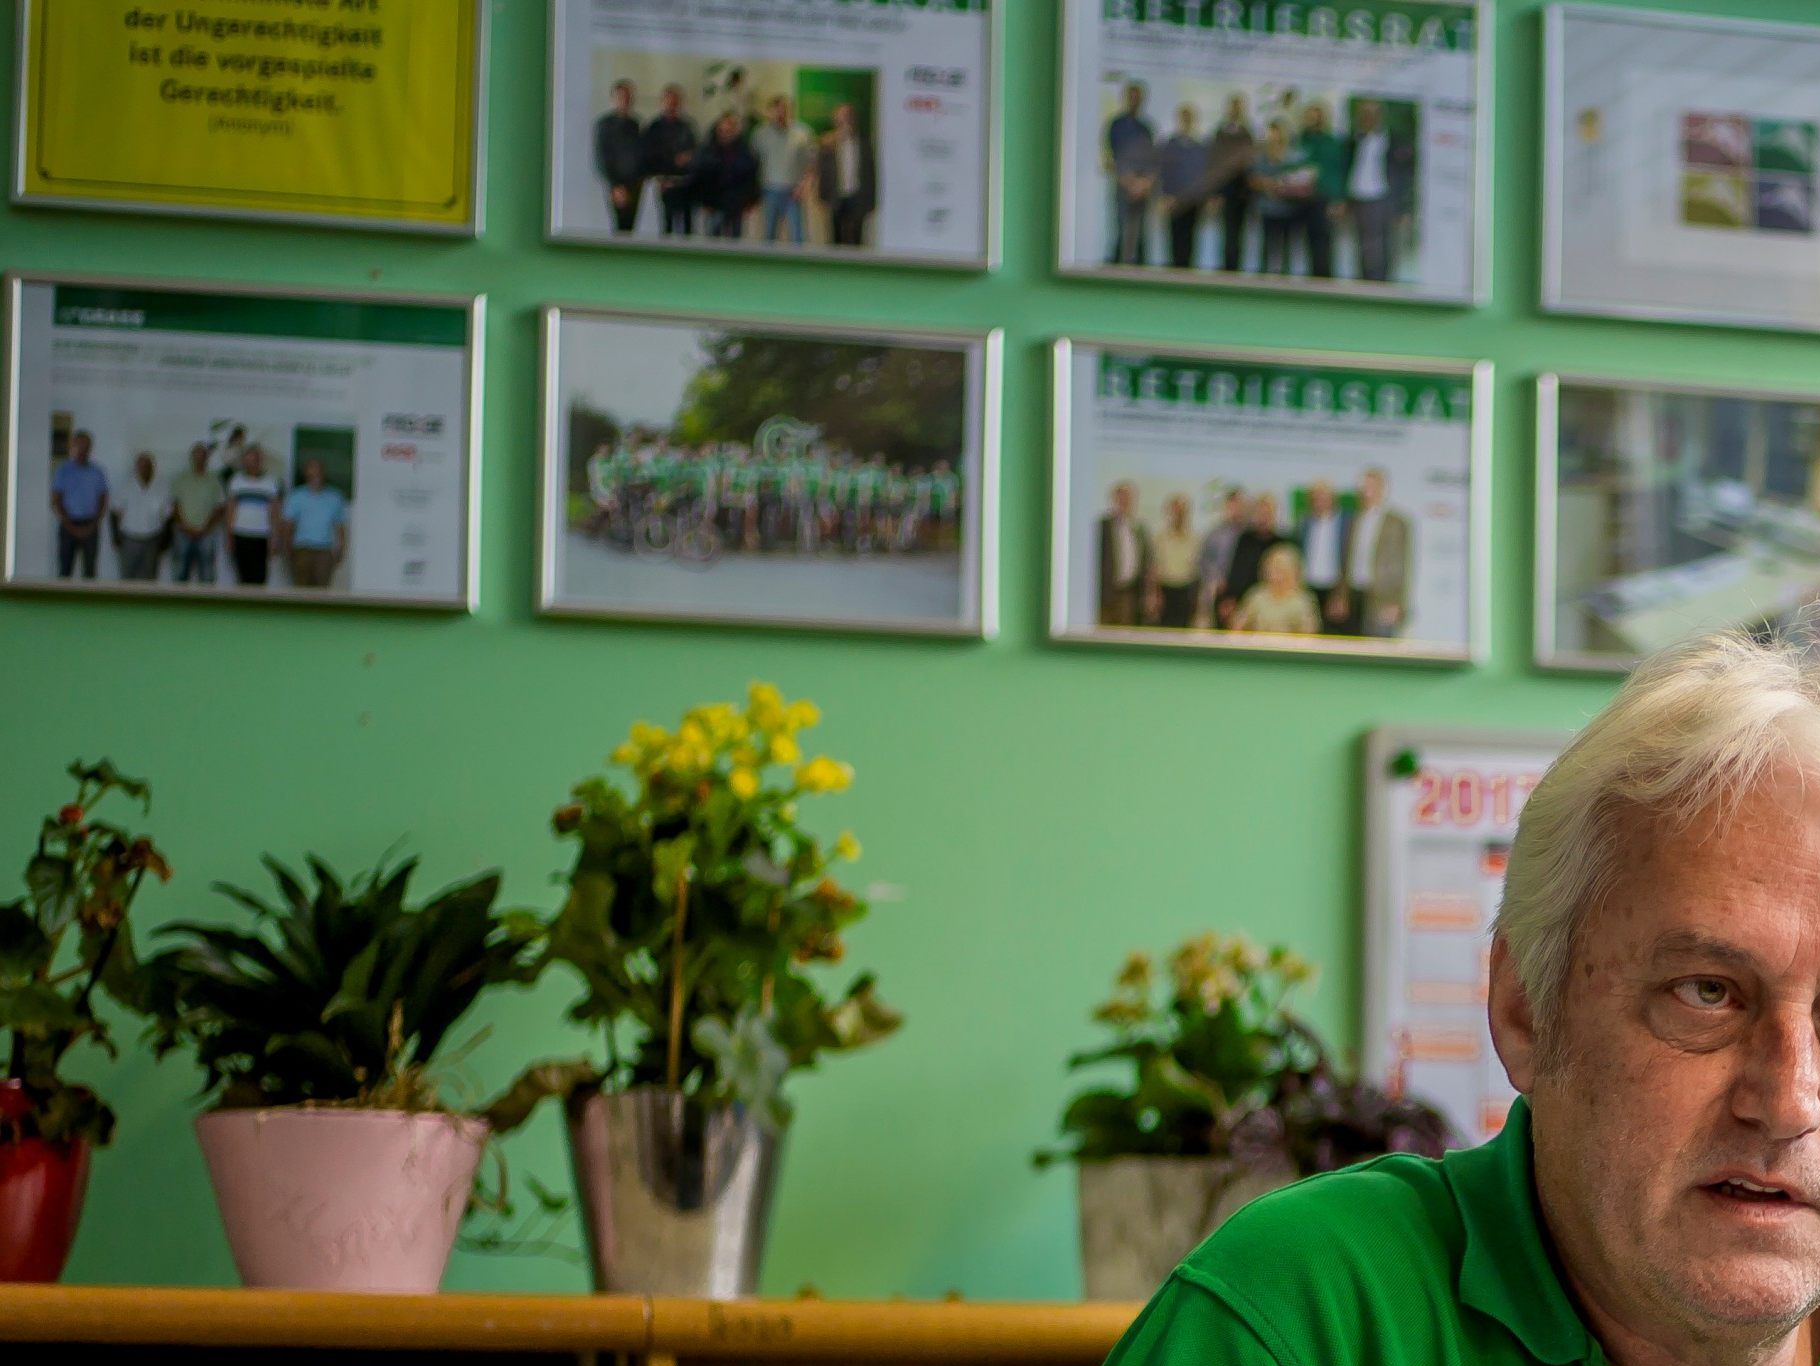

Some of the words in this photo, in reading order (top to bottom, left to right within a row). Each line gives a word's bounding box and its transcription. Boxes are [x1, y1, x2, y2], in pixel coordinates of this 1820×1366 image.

[125, 7, 167, 29] der
[175, 9, 381, 48] Ungerechtigkeit
[170, 44, 210, 69] die
